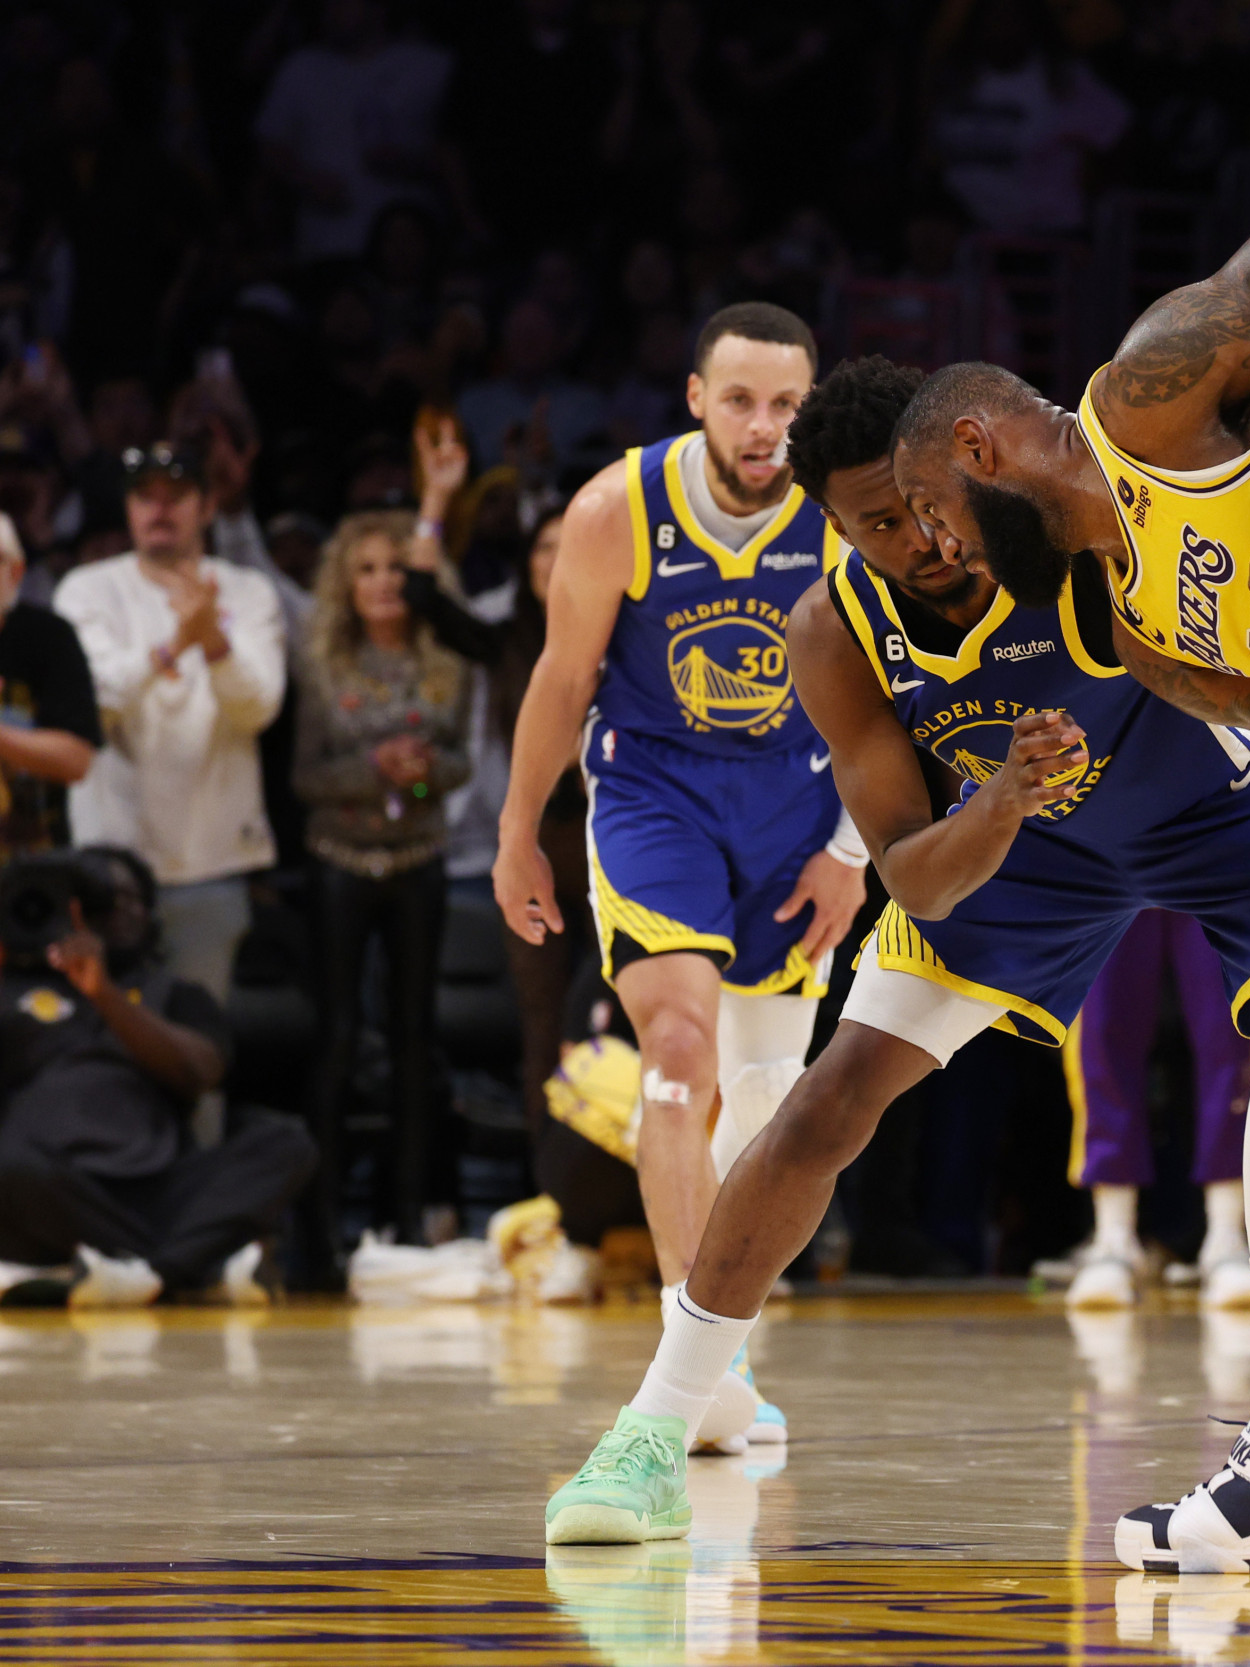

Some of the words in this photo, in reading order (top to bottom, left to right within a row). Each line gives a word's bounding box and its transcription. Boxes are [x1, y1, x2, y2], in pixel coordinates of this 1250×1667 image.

[1133, 485, 1151, 528] bibigo
[657, 525, 675, 550] 6
[761, 552, 818, 569] Rakuten
[886, 634, 905, 661] 6
[992, 638, 1056, 661] Rakuten
[736, 646, 785, 679] 30
